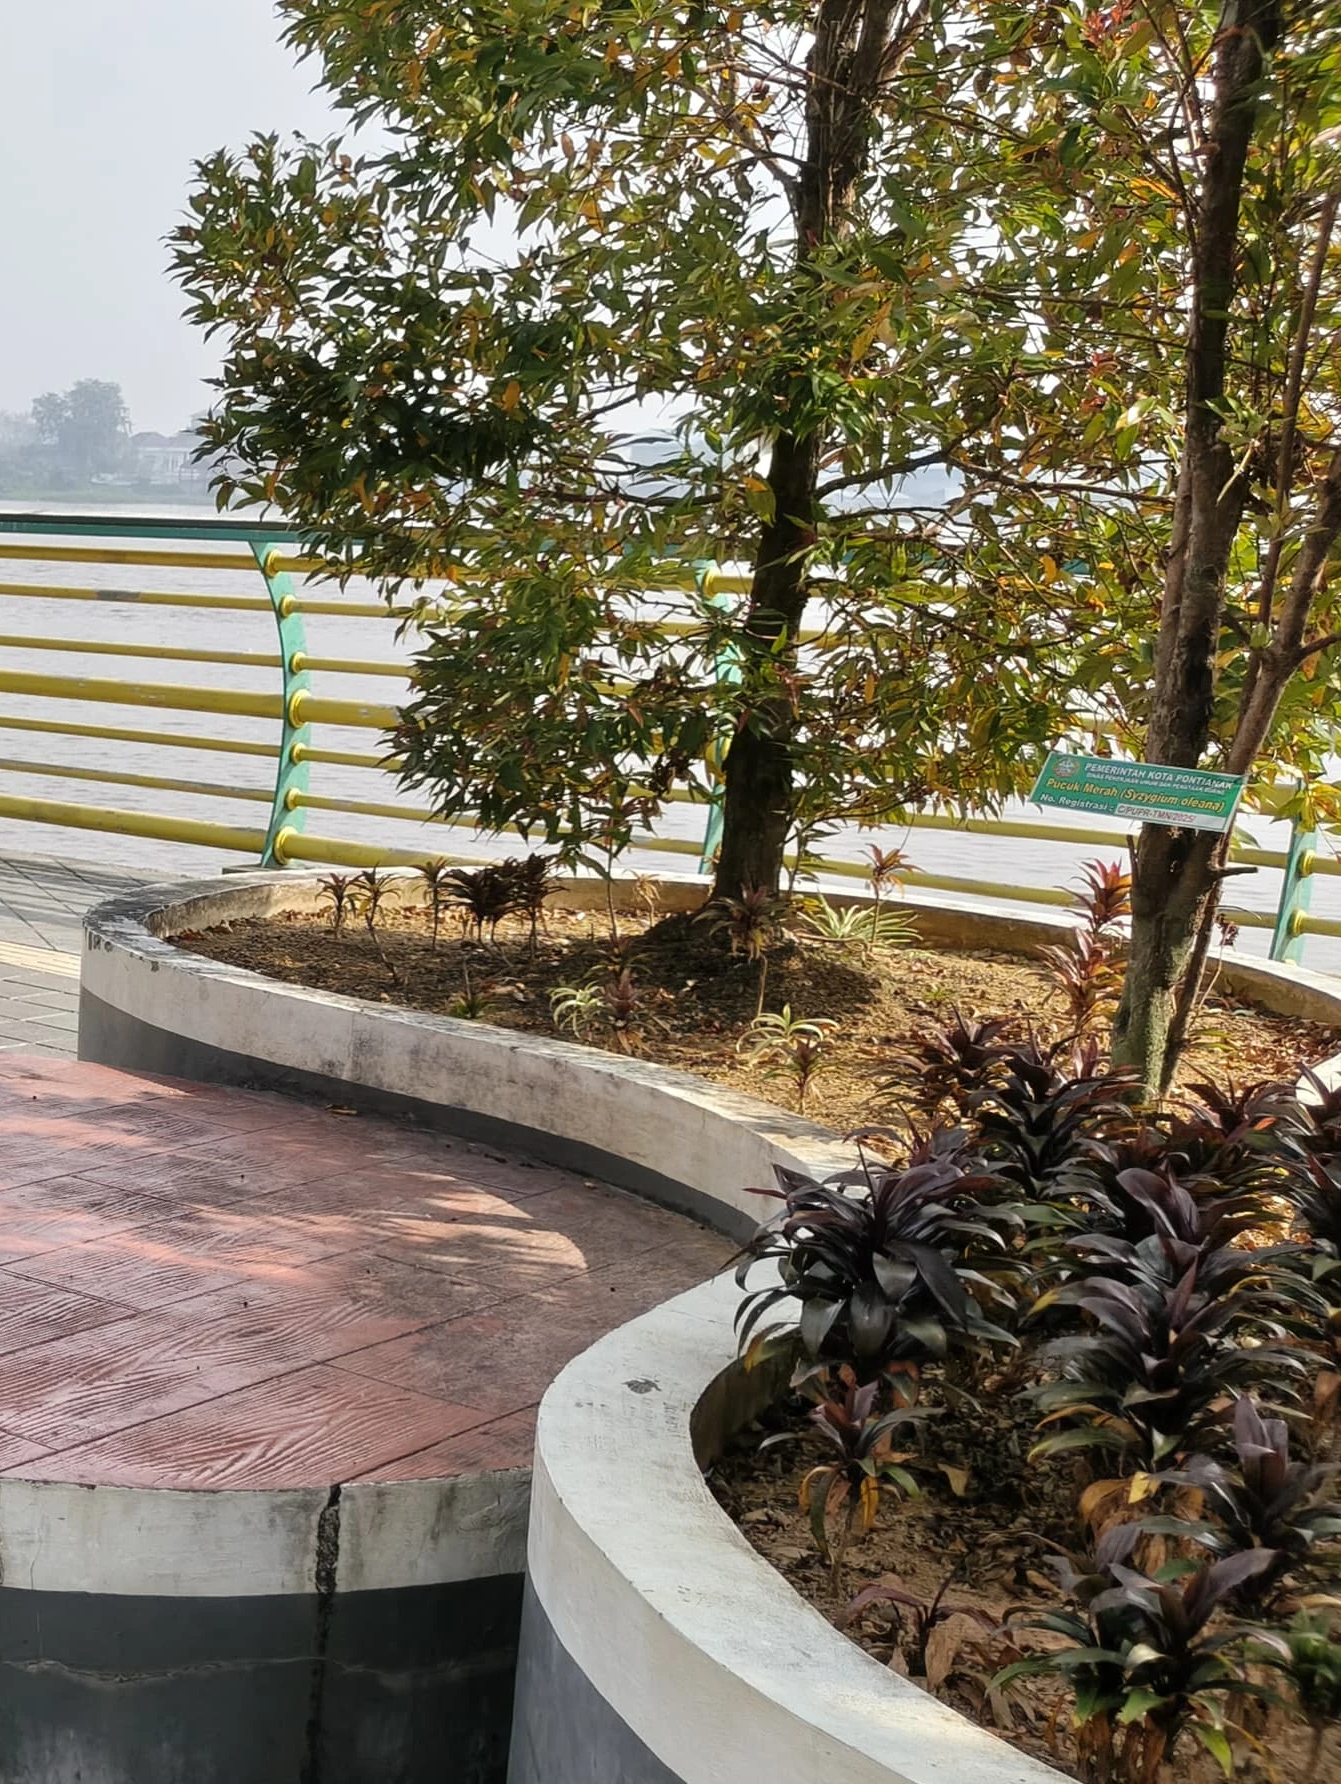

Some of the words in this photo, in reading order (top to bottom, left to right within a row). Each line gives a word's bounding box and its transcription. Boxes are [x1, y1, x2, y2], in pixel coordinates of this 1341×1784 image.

[1085, 762, 1145, 778] PEMERINTAH
[1148, 770, 1174, 781] KOTA
[1175, 774, 1233, 789] PONTIANAK
[1040, 793, 1056, 803] No.
[1058, 796, 1108, 810] Registrasi
[1046, 778, 1080, 792] Pucuk
[1083, 783, 1117, 797] Merah
[1121, 788, 1178, 805] (Syzygium
[1181, 797, 1226, 813] oleana)
